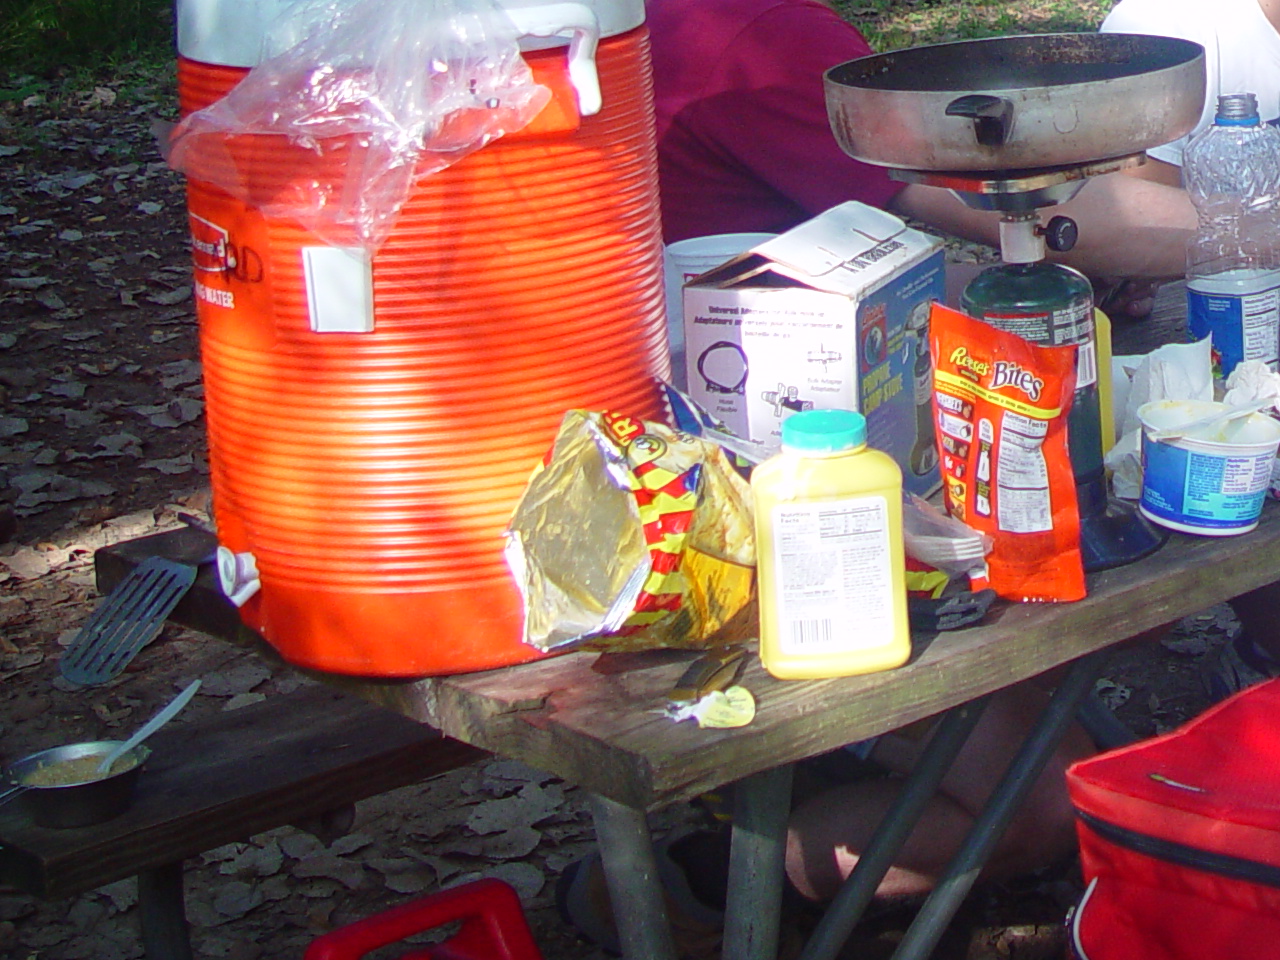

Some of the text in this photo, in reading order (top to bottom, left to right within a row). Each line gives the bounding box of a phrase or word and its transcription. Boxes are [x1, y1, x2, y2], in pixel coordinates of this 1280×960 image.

[205, 286, 235, 309] WATER
[950, 347, 990, 376] Reese's
[991, 361, 1044, 402] Bites
